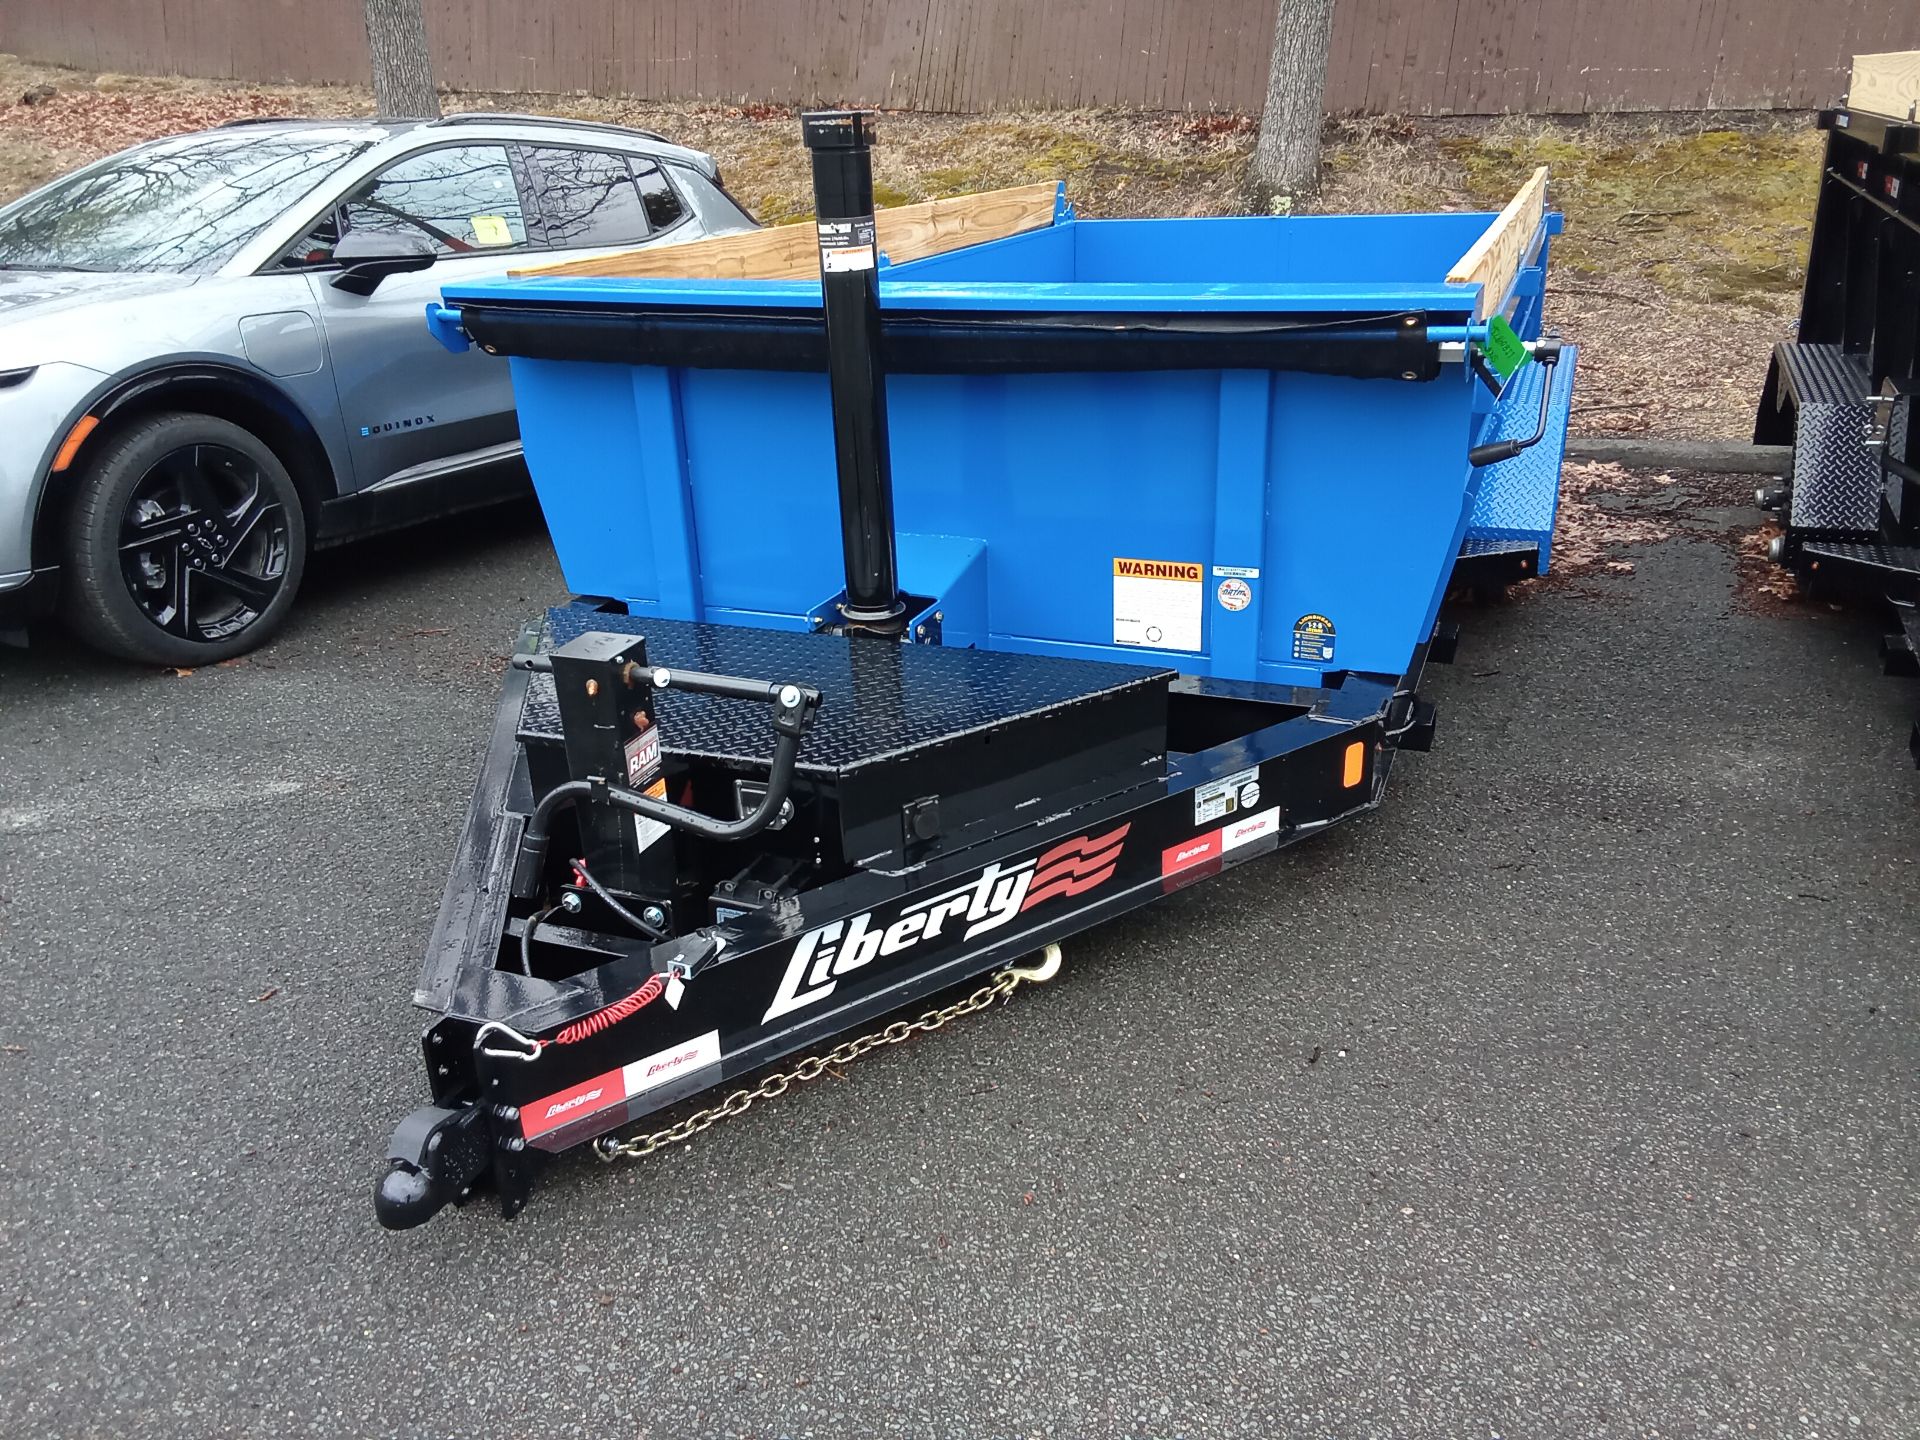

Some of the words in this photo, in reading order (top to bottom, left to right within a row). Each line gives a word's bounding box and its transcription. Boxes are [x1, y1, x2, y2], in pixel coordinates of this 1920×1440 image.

[361, 414, 435, 437] EQUINOX
[1118, 561, 1198, 579] WARNING
[630, 741, 658, 776] RAM
[761, 857, 1038, 1026] Liberty
[646, 1056, 683, 1076] Liberty
[545, 1095, 586, 1118] Liberty
